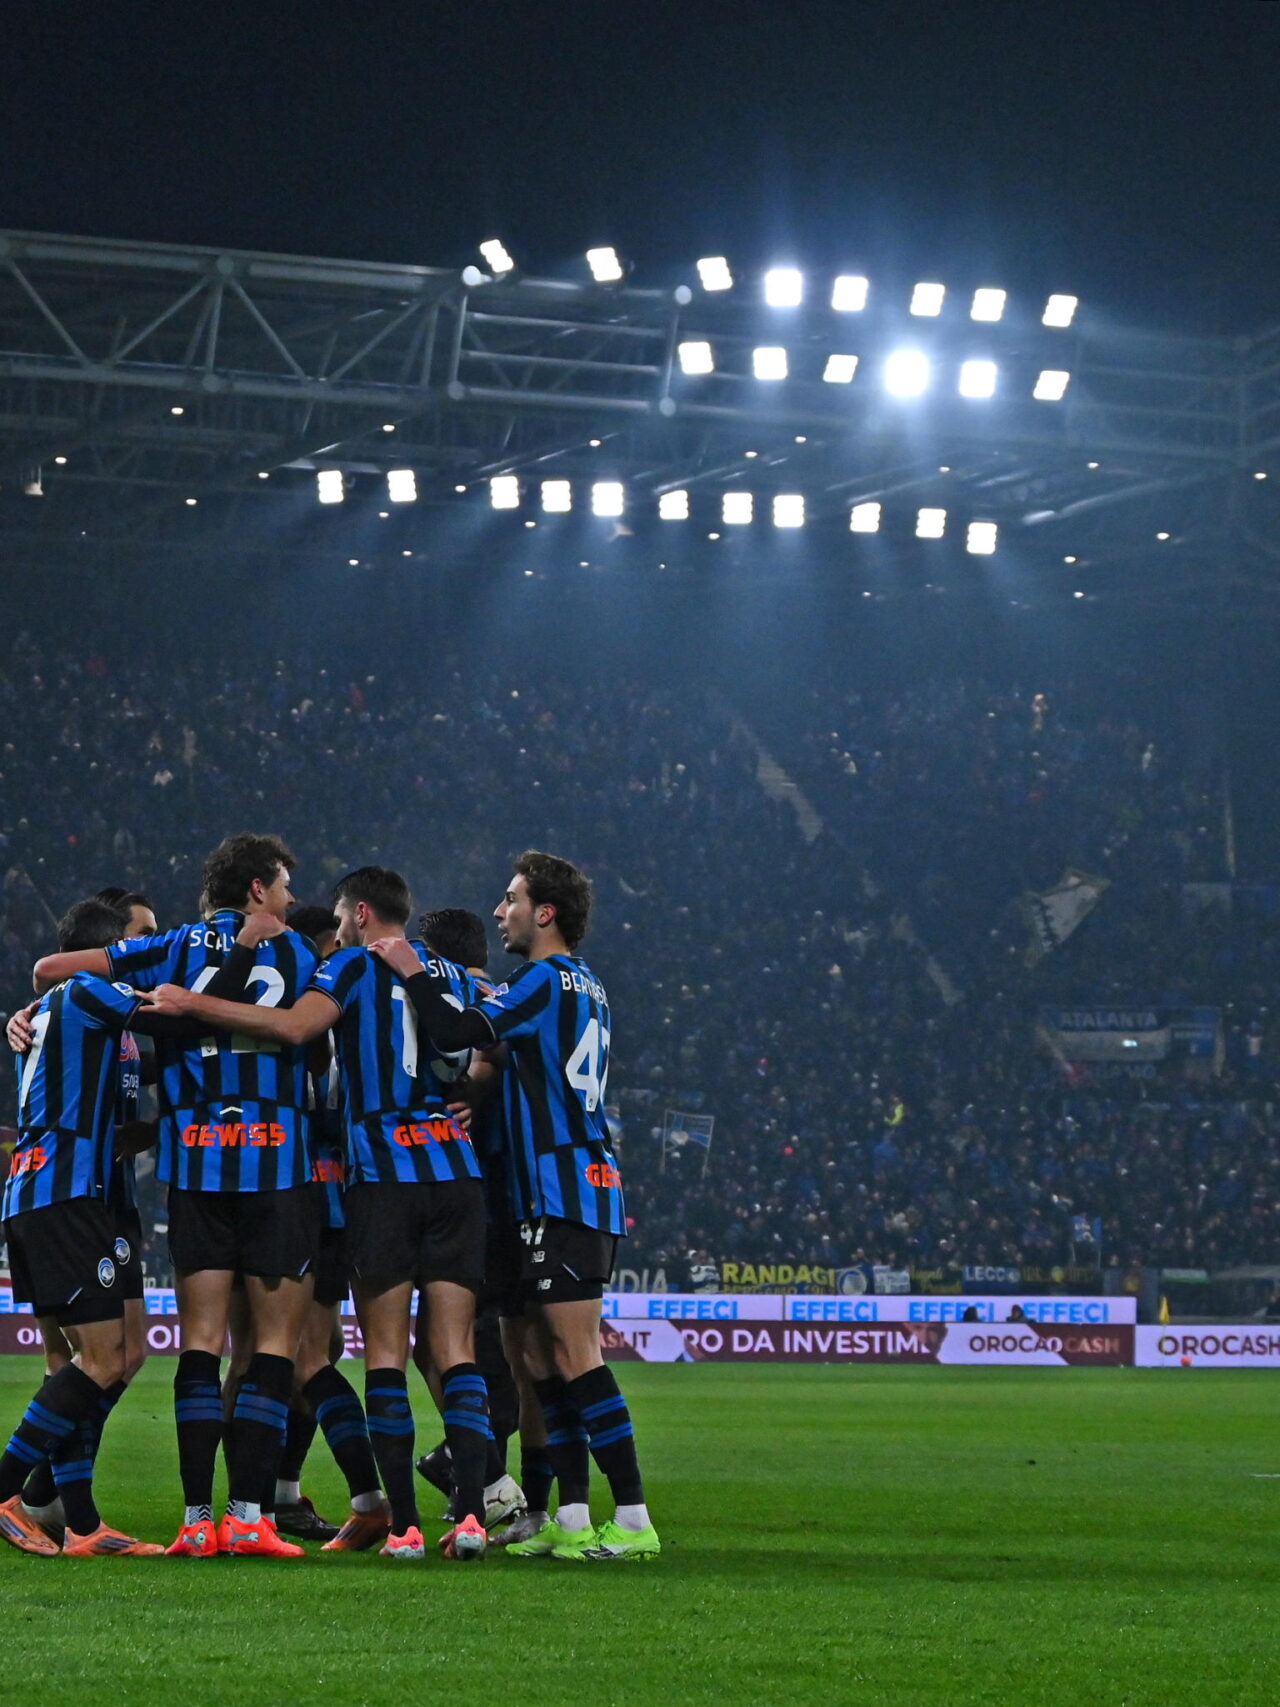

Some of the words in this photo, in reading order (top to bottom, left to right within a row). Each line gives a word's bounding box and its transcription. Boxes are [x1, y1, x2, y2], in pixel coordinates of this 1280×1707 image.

[565, 1018, 610, 1113] 47
[722, 1262, 836, 1288] RANDAGI
[648, 1300, 738, 1319] EFFECI
[791, 1301, 877, 1321] EFFECI
[1023, 1302, 1108, 1323] EFFECI
[732, 1329, 776, 1353] DA
[1157, 1335, 1280, 1356] OROCASH
